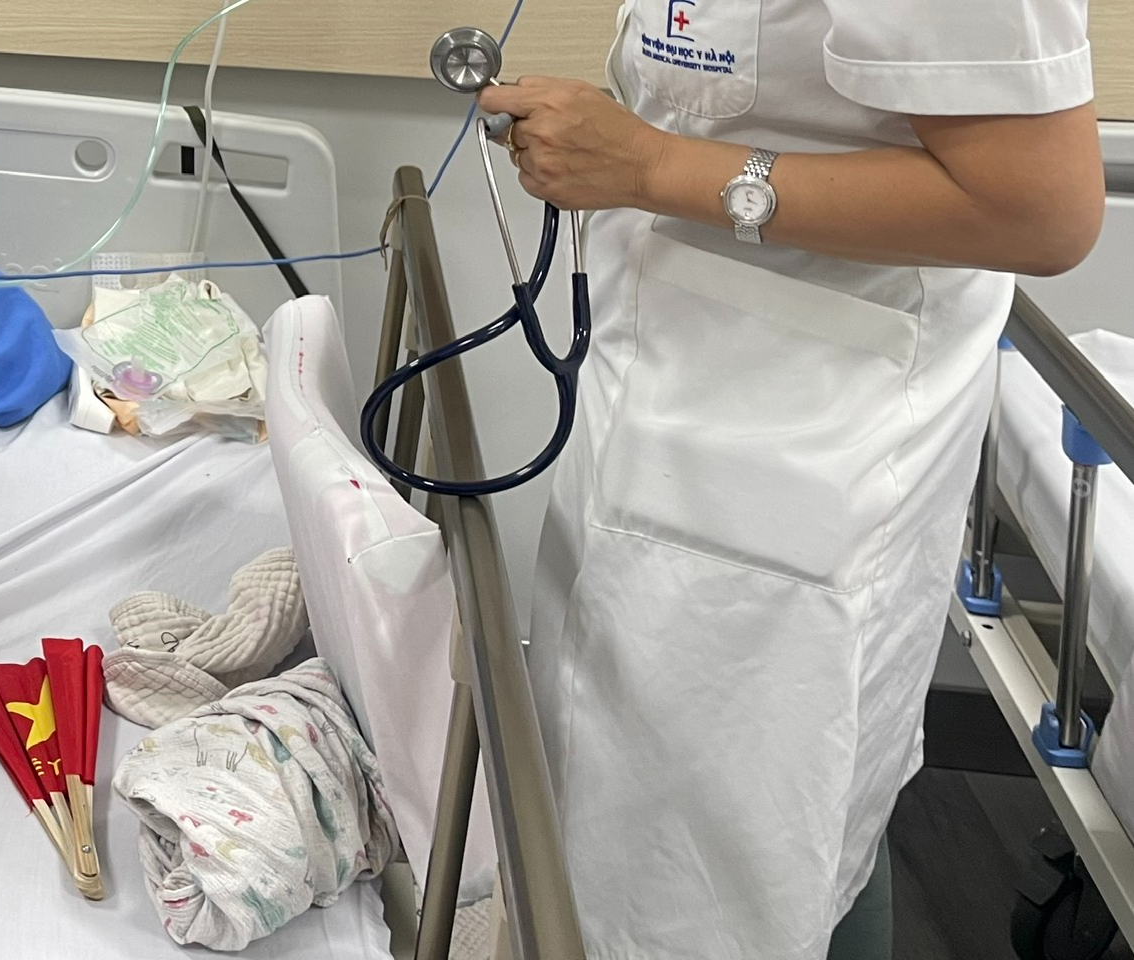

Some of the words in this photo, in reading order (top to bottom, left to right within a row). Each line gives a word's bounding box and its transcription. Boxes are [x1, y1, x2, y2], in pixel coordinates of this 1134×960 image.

[678, 48, 695, 60] HỌC
[696, 50, 703, 60] Y
[705, 47, 718, 62] HÀ
[719, 49, 735, 65] NỘI
[702, 64, 734, 75] HOSPITAL
